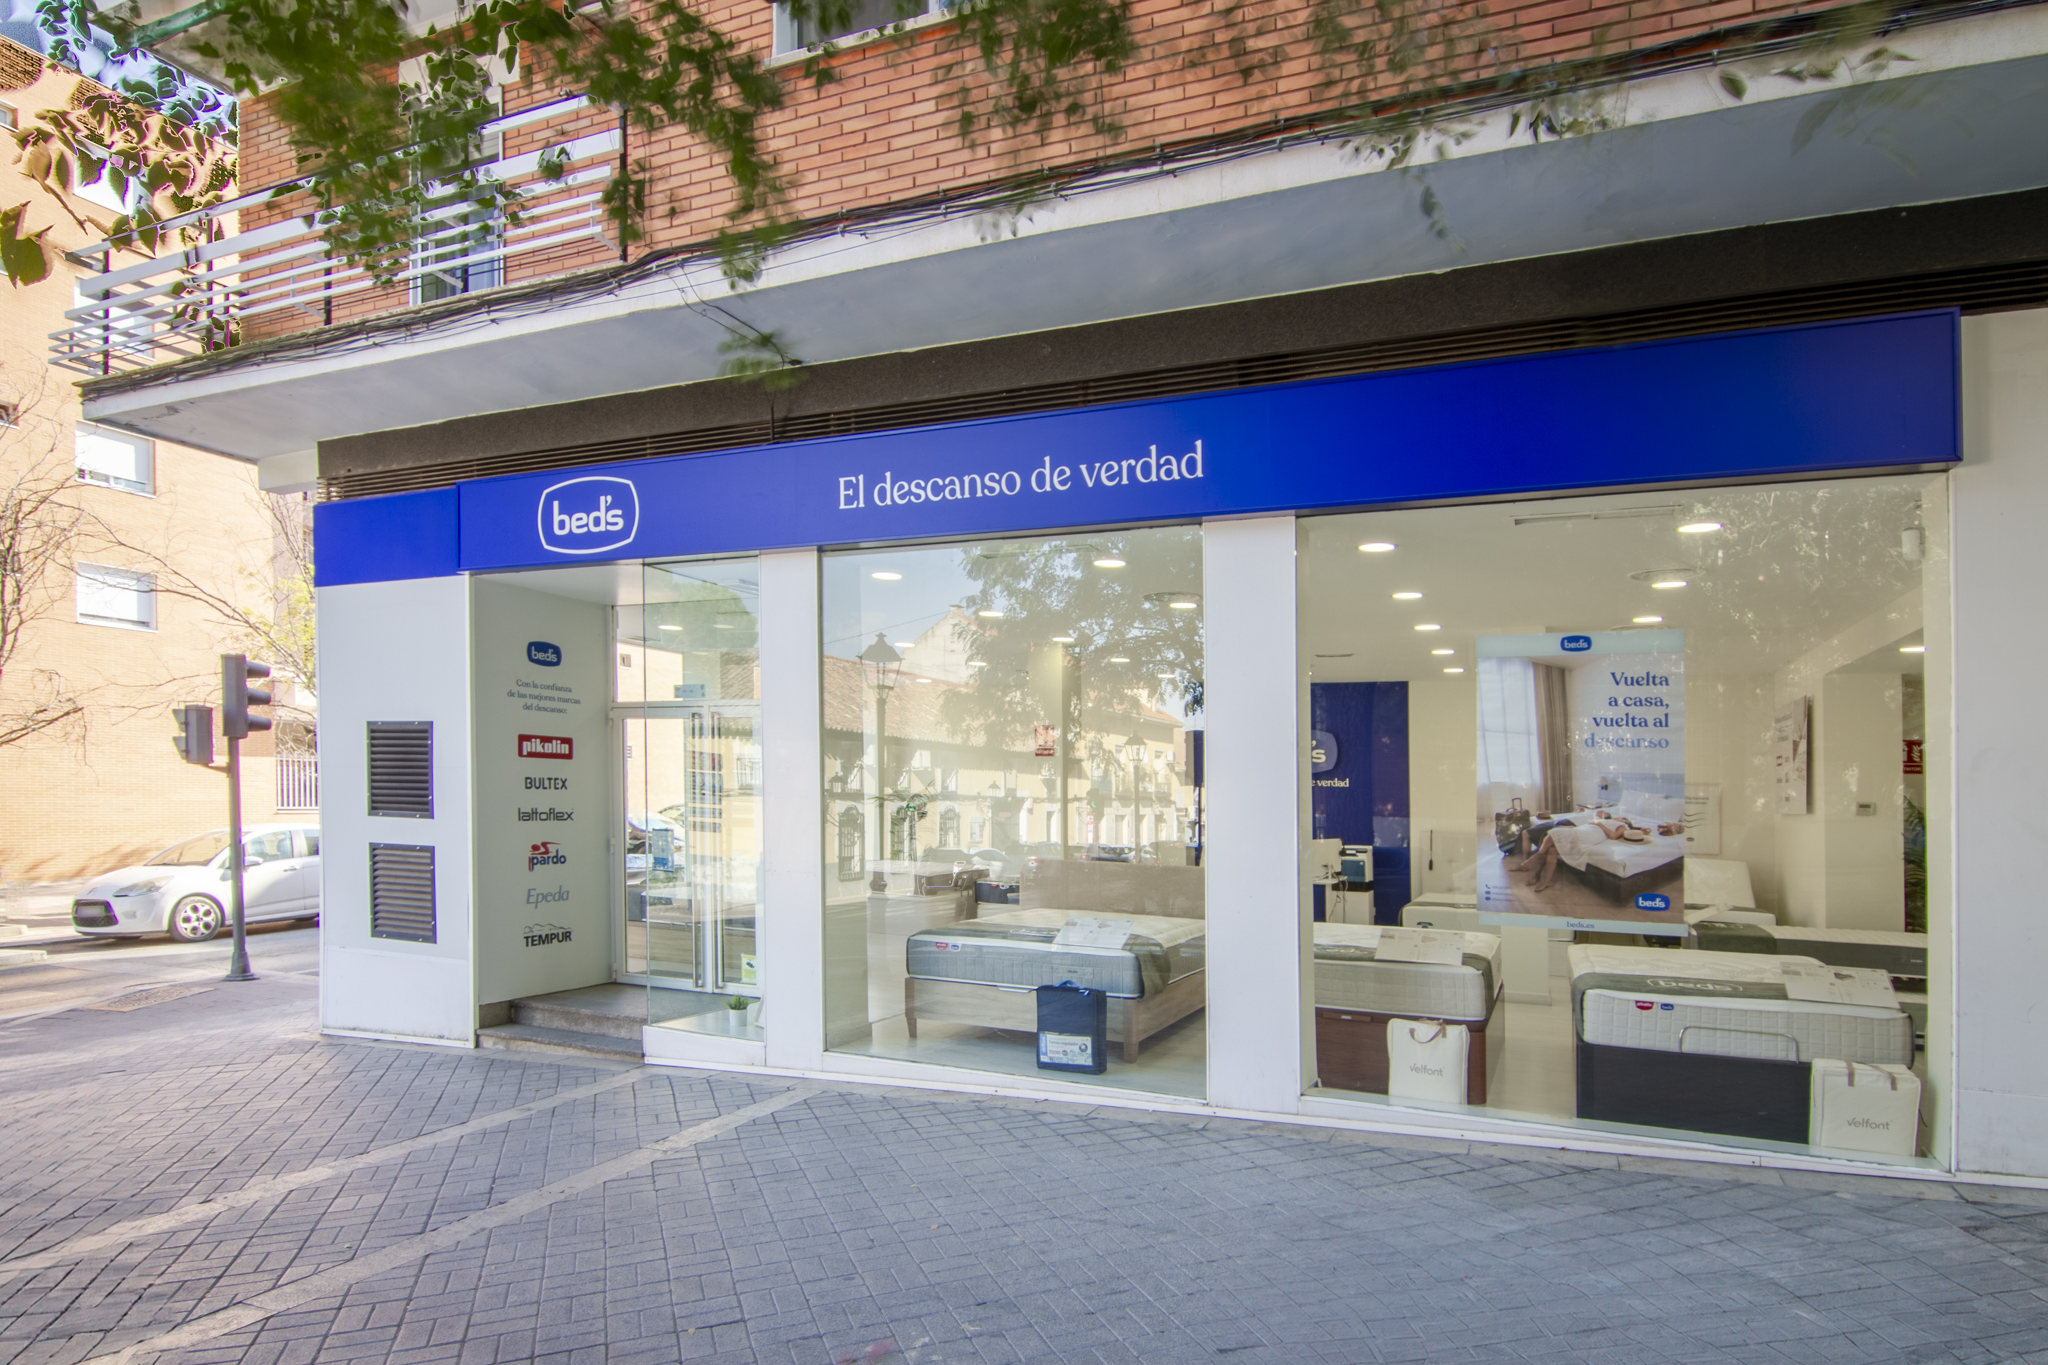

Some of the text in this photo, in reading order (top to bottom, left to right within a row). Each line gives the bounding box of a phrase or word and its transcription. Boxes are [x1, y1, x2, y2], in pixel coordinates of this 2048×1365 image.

[838, 439, 1204, 510] El descanso de verdad
[552, 494, 625, 536] bed's
[531, 645, 558, 662] bed's
[516, 678, 573, 693] Con la confianza
[1609, 671, 1671, 687] Vuelta
[507, 689, 516, 698] de
[517, 690, 528, 699] las
[529, 693, 556, 702] mejores
[1608, 696, 1670, 710] a casa,
[522, 702, 568, 714] del descanso:
[1592, 712, 1670, 728] vuelta al
[522, 738, 569, 756] pikolin
[1584, 732, 1670, 749] descanso
[525, 777, 568, 790] BULTEX
[1317, 777, 1350, 787] verdad
[518, 807, 574, 821] lattoflex
[529, 848, 567, 872] pardo
[526, 885, 570, 909] Epeda
[1566, 921, 1595, 929] beds.es
[524, 931, 572, 947] TEMPUR
